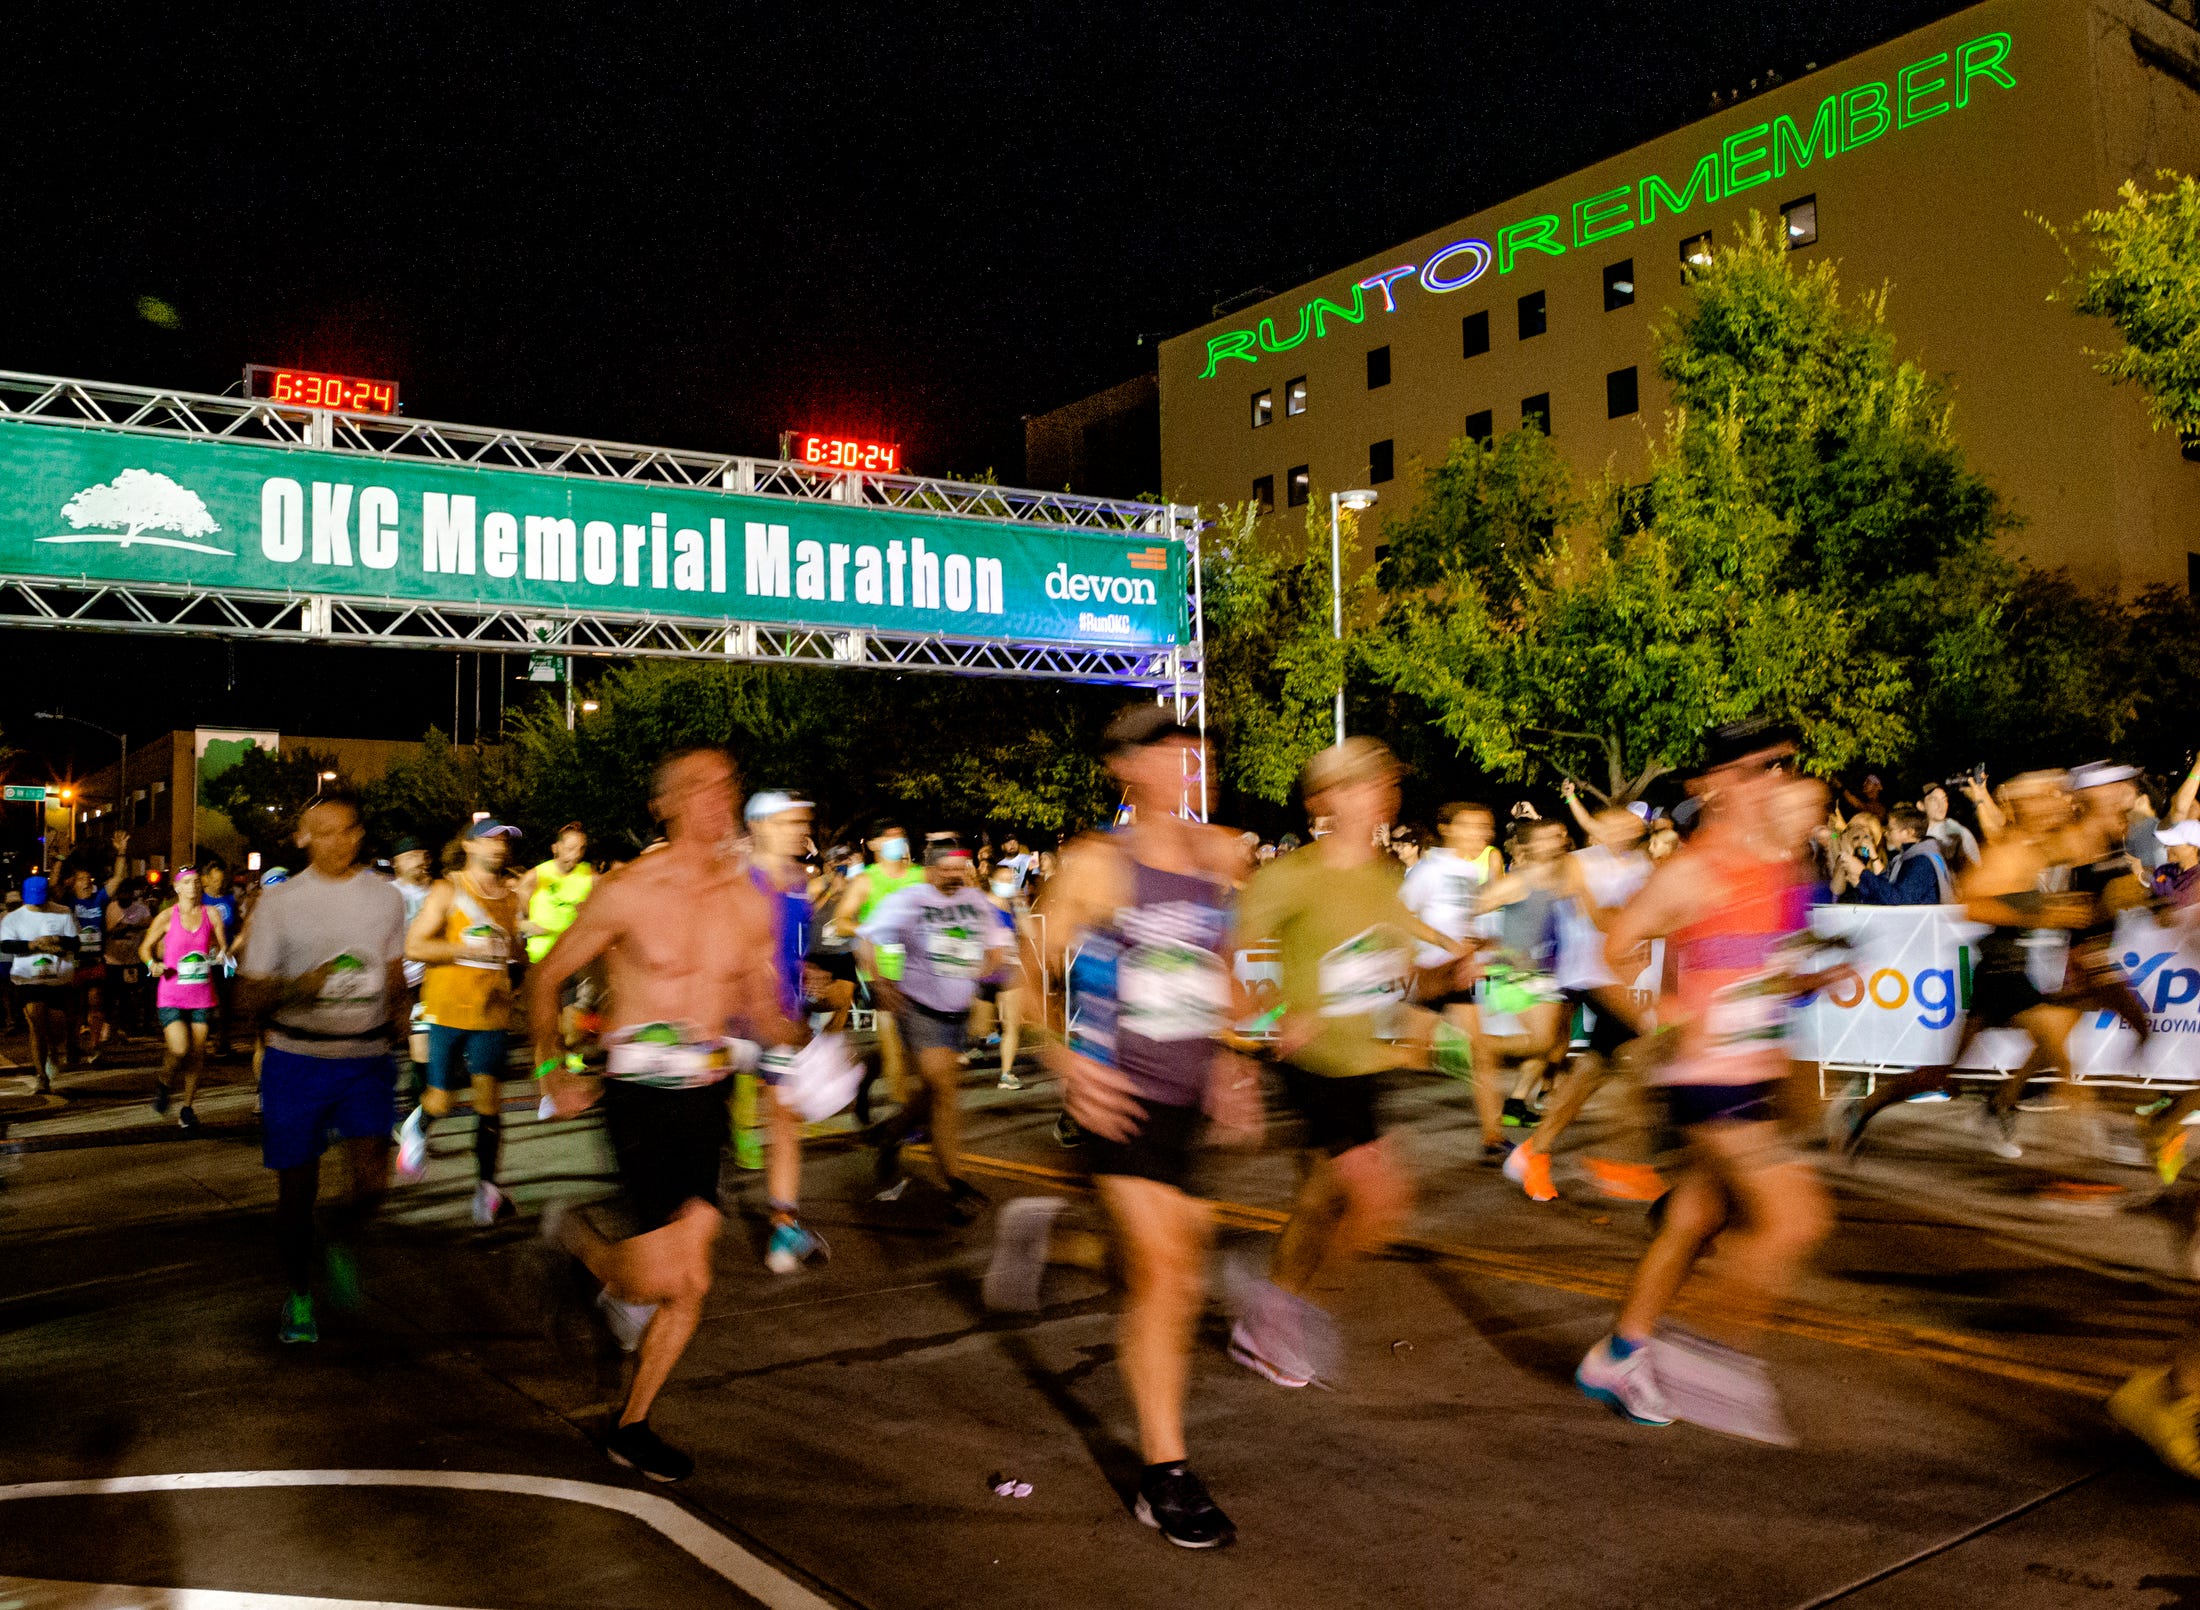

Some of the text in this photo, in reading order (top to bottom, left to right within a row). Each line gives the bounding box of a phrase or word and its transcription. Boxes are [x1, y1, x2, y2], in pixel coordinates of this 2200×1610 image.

[1497, 32, 2017, 275] REMEMBER
[261, 477, 1004, 614] OKC Memorial Marathon
[1045, 562, 1158, 605] devon
[1079, 612, 1131, 634] #RunOKC
